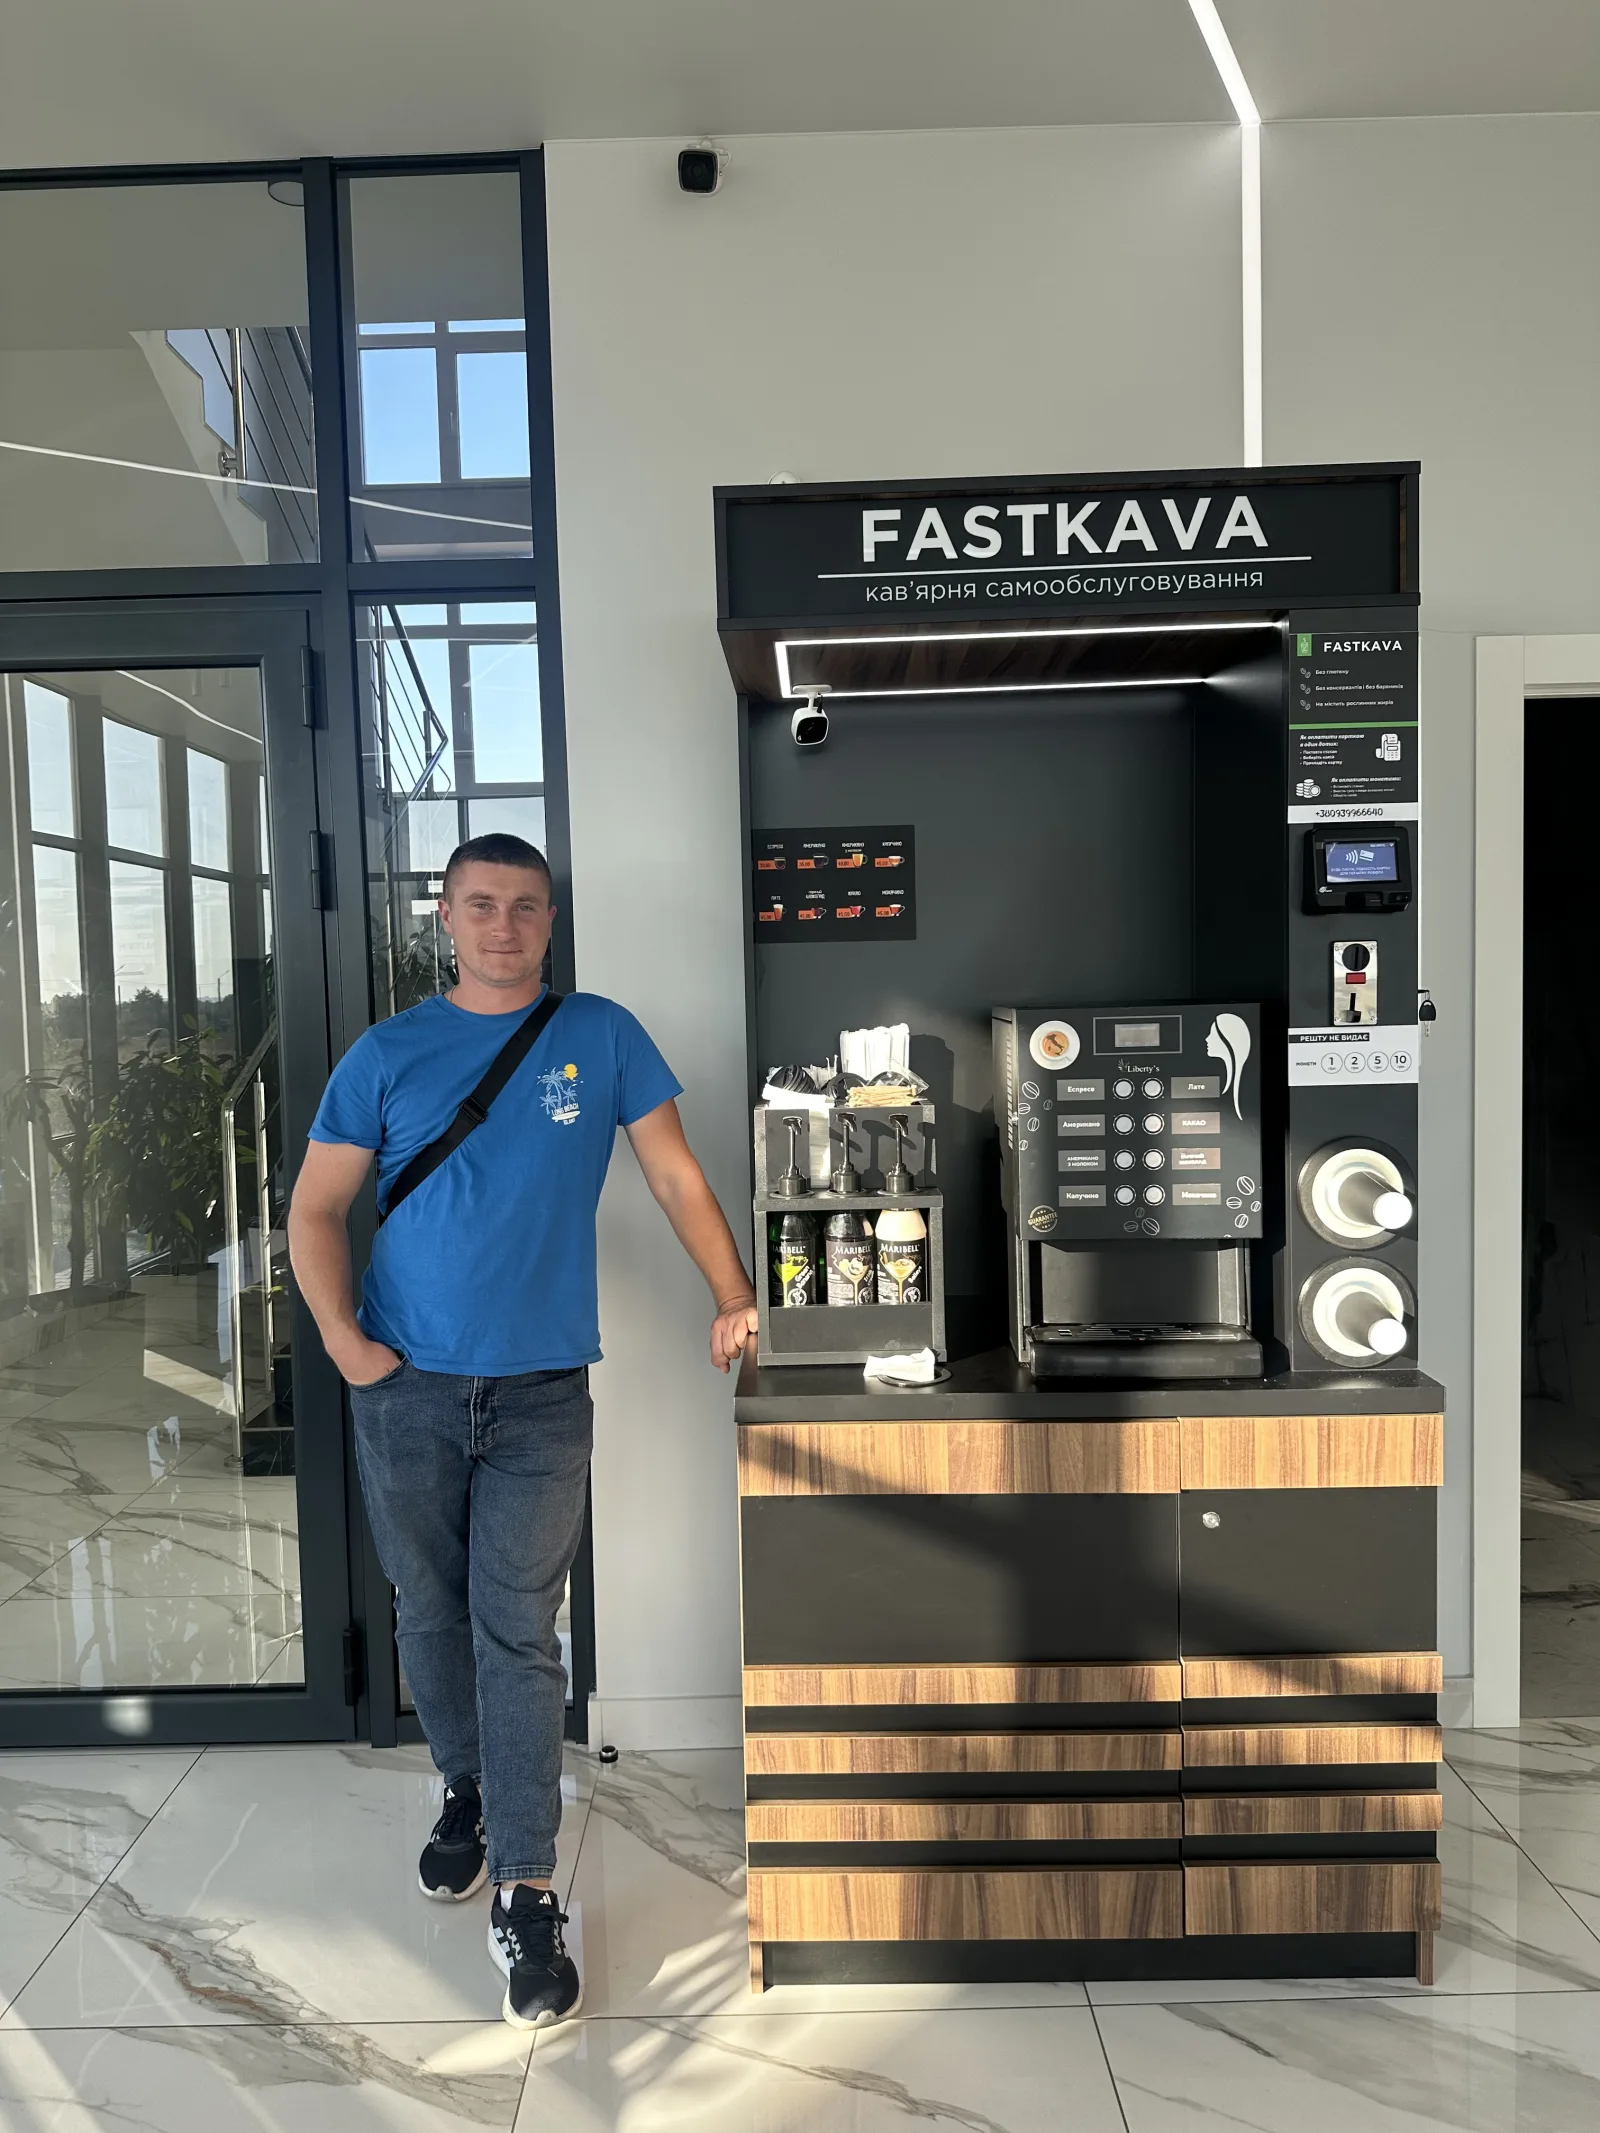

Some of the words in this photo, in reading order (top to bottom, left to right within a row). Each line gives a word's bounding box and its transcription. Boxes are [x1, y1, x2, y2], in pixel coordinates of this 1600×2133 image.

[862, 496, 1269, 562] FASTKAVA
[866, 581, 977, 603] кав'ярня
[986, 572, 1264, 598] самообслуговування
[1324, 640, 1402, 652] FASTKAVA
[1329, 1057, 1334, 1066] 1
[1351, 1056, 1358, 1065] 2
[1374, 1055, 1381, 1065] 5
[1394, 1055, 1407, 1064] 10
[1127, 1065, 1160, 1074] Liberty's
[1067, 1086, 1095, 1094] Еспресо
[1188, 1083, 1206, 1091] Лате
[1063, 1121, 1101, 1129] Американо
[1066, 1192, 1099, 1201] Капучино
[1027, 1211, 1058, 1226] GUARANTEE
[835, 1245, 871, 1255] MARIBELL
[881, 1243, 919, 1253] MARIBELL
